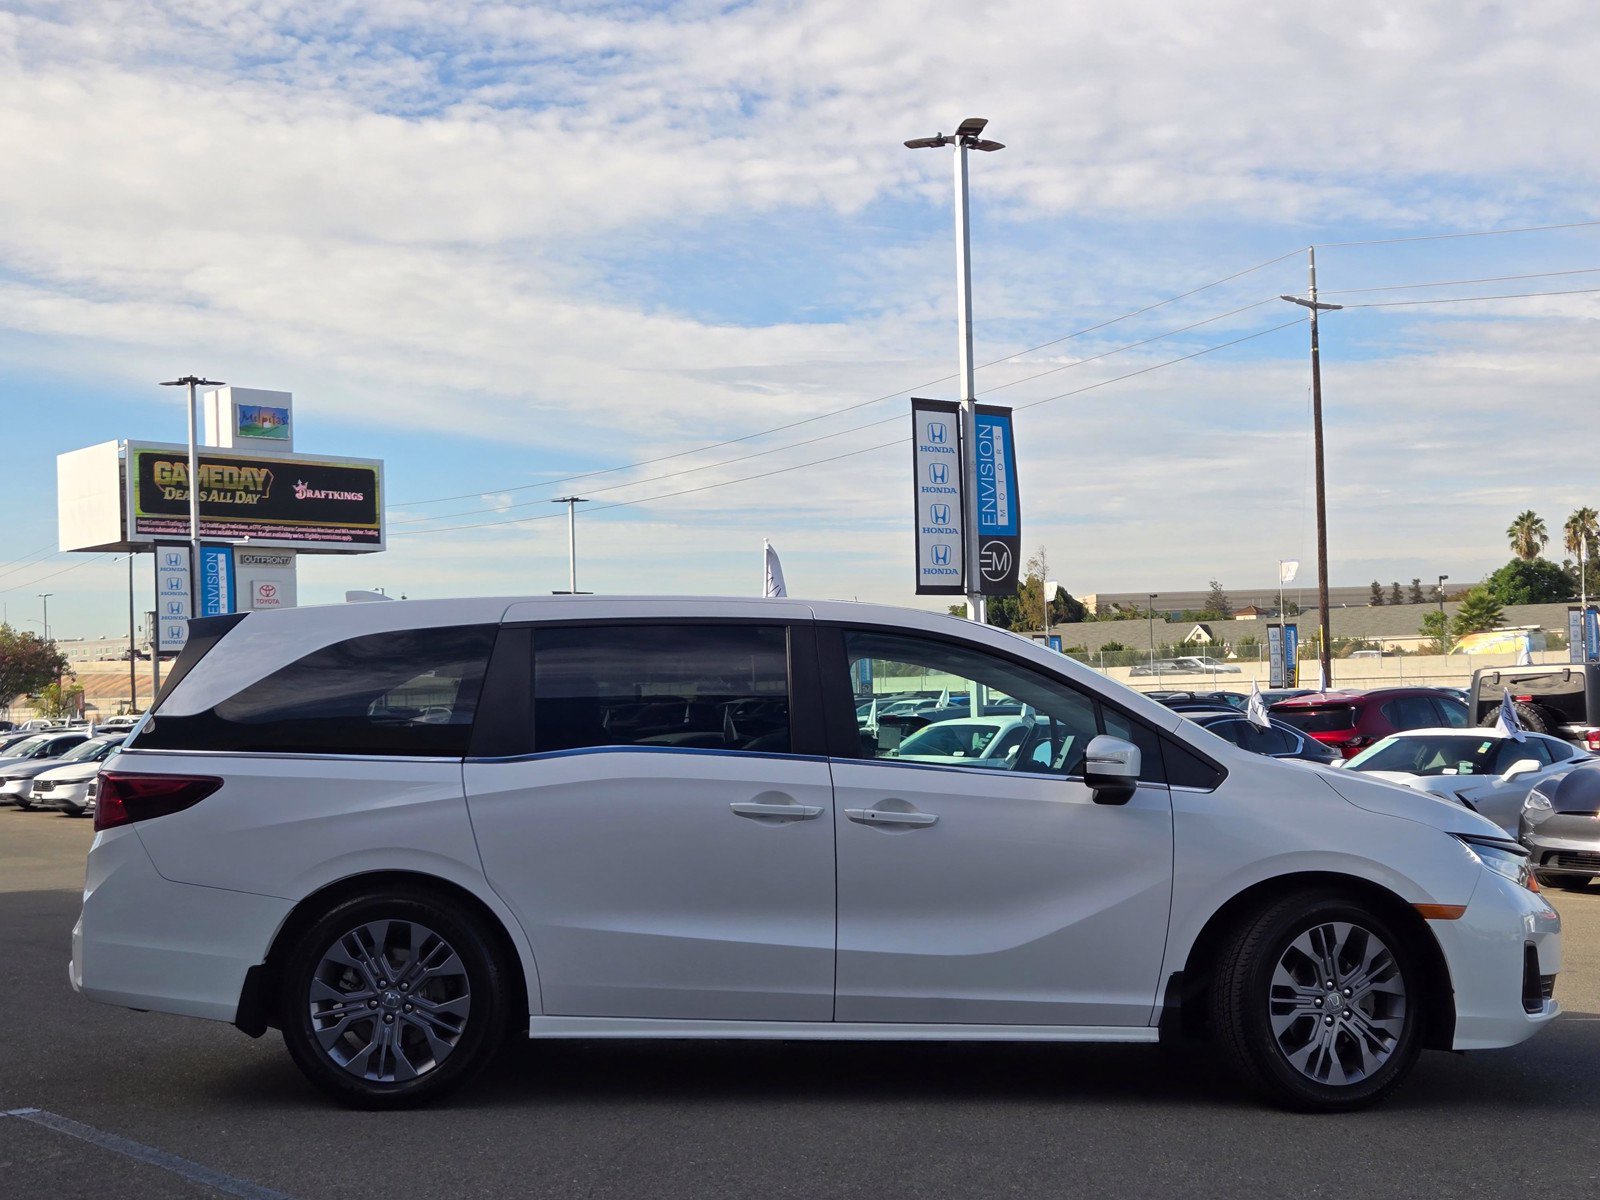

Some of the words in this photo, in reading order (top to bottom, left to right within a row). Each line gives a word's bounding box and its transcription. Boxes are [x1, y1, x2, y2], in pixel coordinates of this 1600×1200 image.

[919, 445, 956, 454] HONDA
[978, 424, 997, 526] ENVISION
[995, 434, 1007, 518] MOTORS
[163, 487, 208, 502] DEAS
[208, 490, 234, 503] ALL
[234, 491, 261, 505] DAY
[295, 488, 364, 501] DRAFTKINGS
[921, 486, 957, 494] HONDA
[922, 527, 959, 535] HONDA
[922, 567, 959, 575] HONDA
[206, 552, 219, 615] ENVISION
